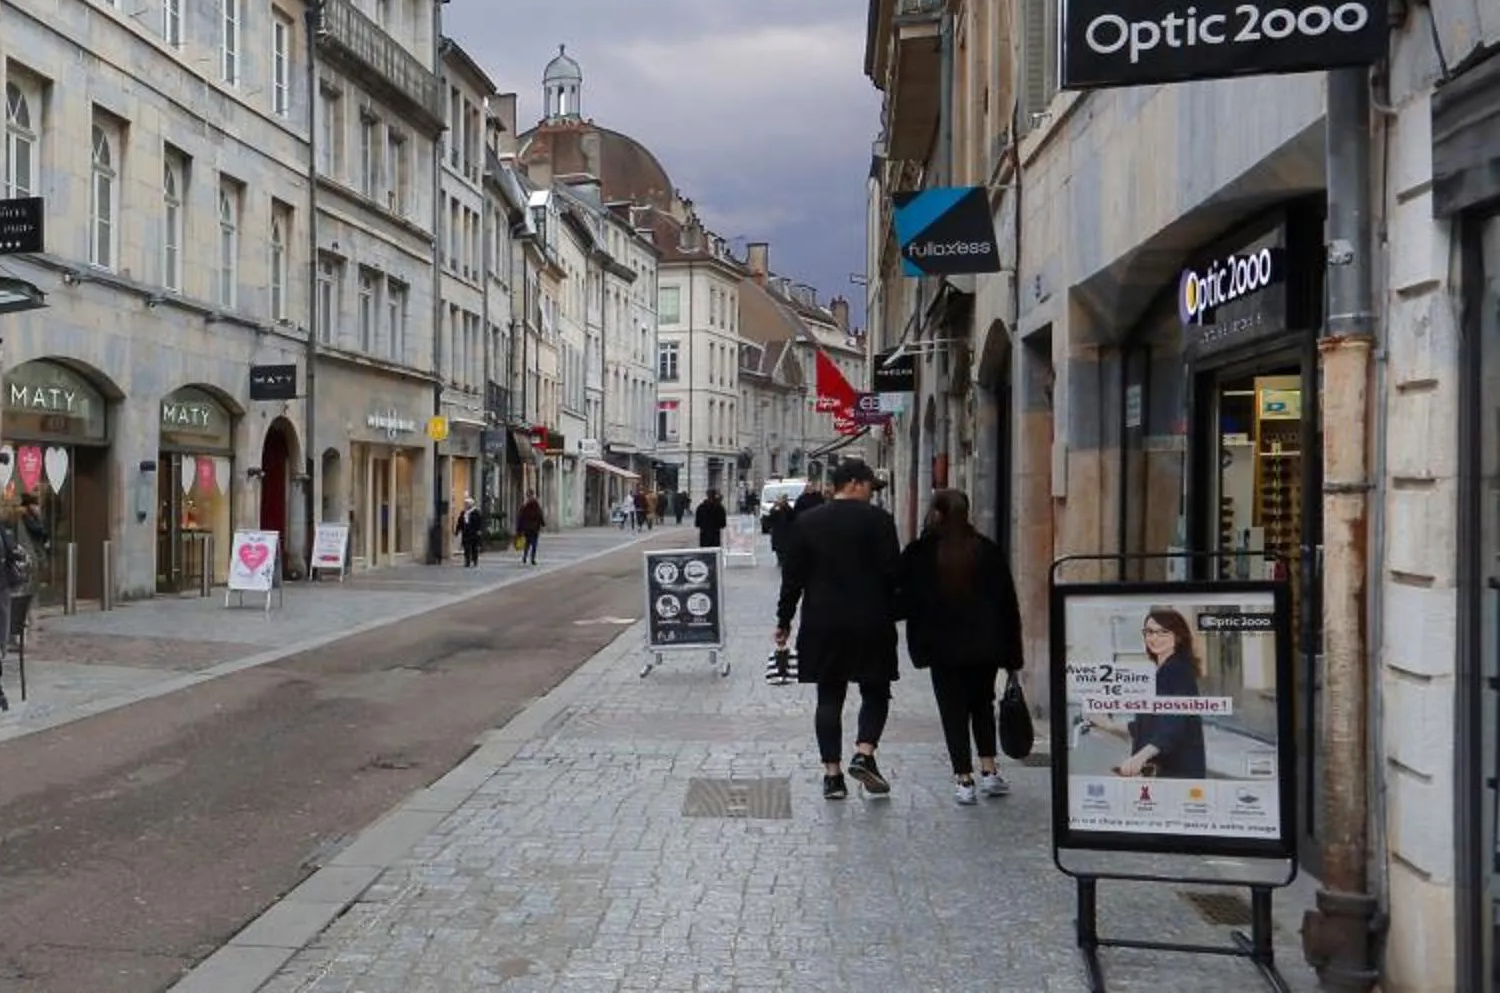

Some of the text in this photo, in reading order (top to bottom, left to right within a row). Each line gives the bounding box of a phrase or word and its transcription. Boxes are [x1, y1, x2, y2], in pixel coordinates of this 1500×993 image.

[1086, 2, 1369, 64] Optic 2000
[1227, 248, 1271, 300] 2000
[11, 383, 76, 411] MATY
[163, 404, 210, 426] MATY
[1100, 664, 1114, 683] 2
[1103, 684, 1124, 696] 1€
[1087, 697, 1121, 711] Tout
[1124, 700, 1148, 711] est
